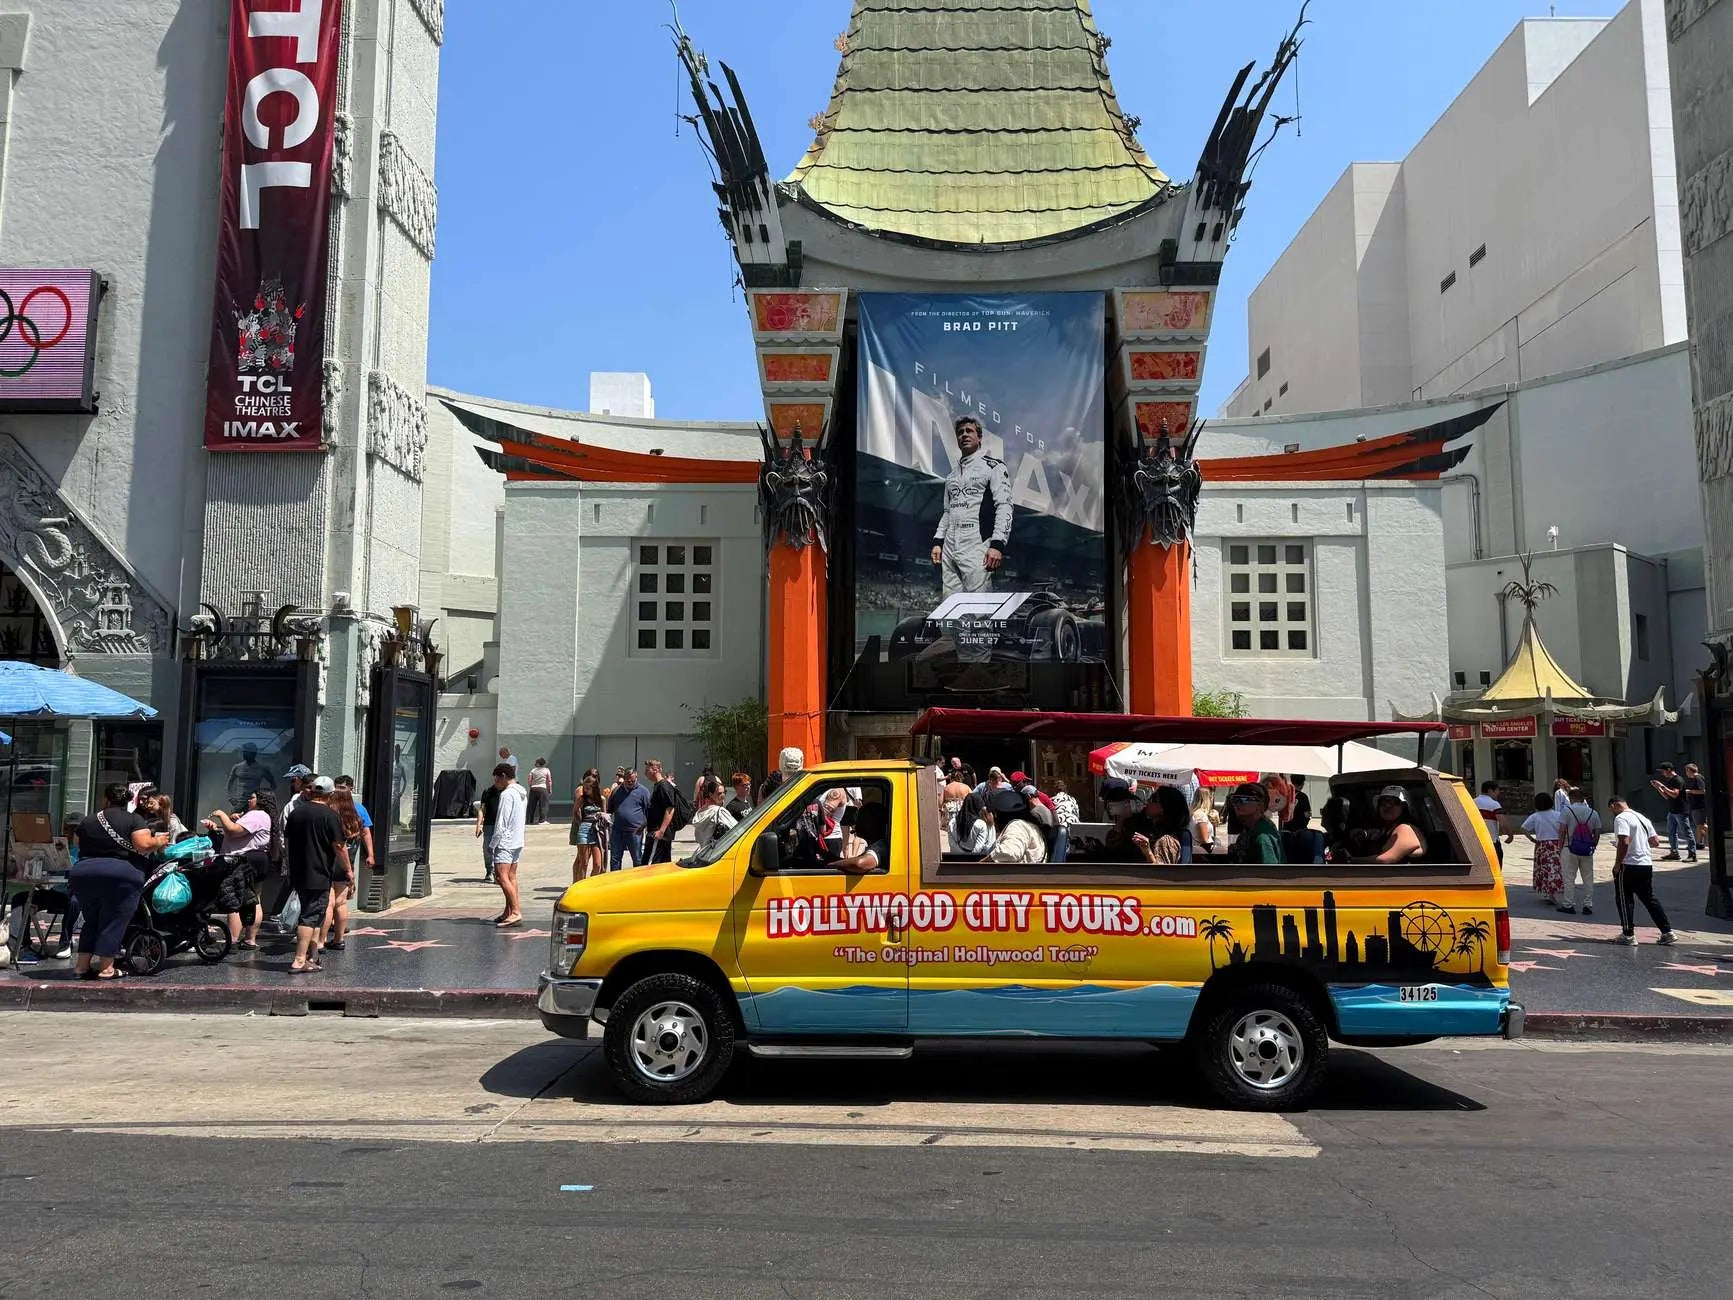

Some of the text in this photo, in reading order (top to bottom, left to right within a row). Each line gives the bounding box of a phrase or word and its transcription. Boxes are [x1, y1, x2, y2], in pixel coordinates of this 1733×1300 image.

[239, 0, 322, 229] TCL
[943, 322, 1018, 331] BRAD PITT
[237, 375, 292, 393] TCL
[235, 395, 291, 407] CHINESE
[914, 361, 1046, 450] FILMED FOR
[235, 406, 291, 416] THEATRES
[223, 421, 302, 438] IMAX
[961, 620, 1008, 628] MOVIE
[1124, 768, 1136, 776] BUY
[1138, 770, 1161, 778] TICKETS
[768, 893, 955, 935] HOLLYWOOD
[965, 892, 1033, 929] CITY
[881, 948, 950, 966] Original
[954, 946, 1044, 966] Hollywood
[1401, 986, 1437, 1001] 34125
